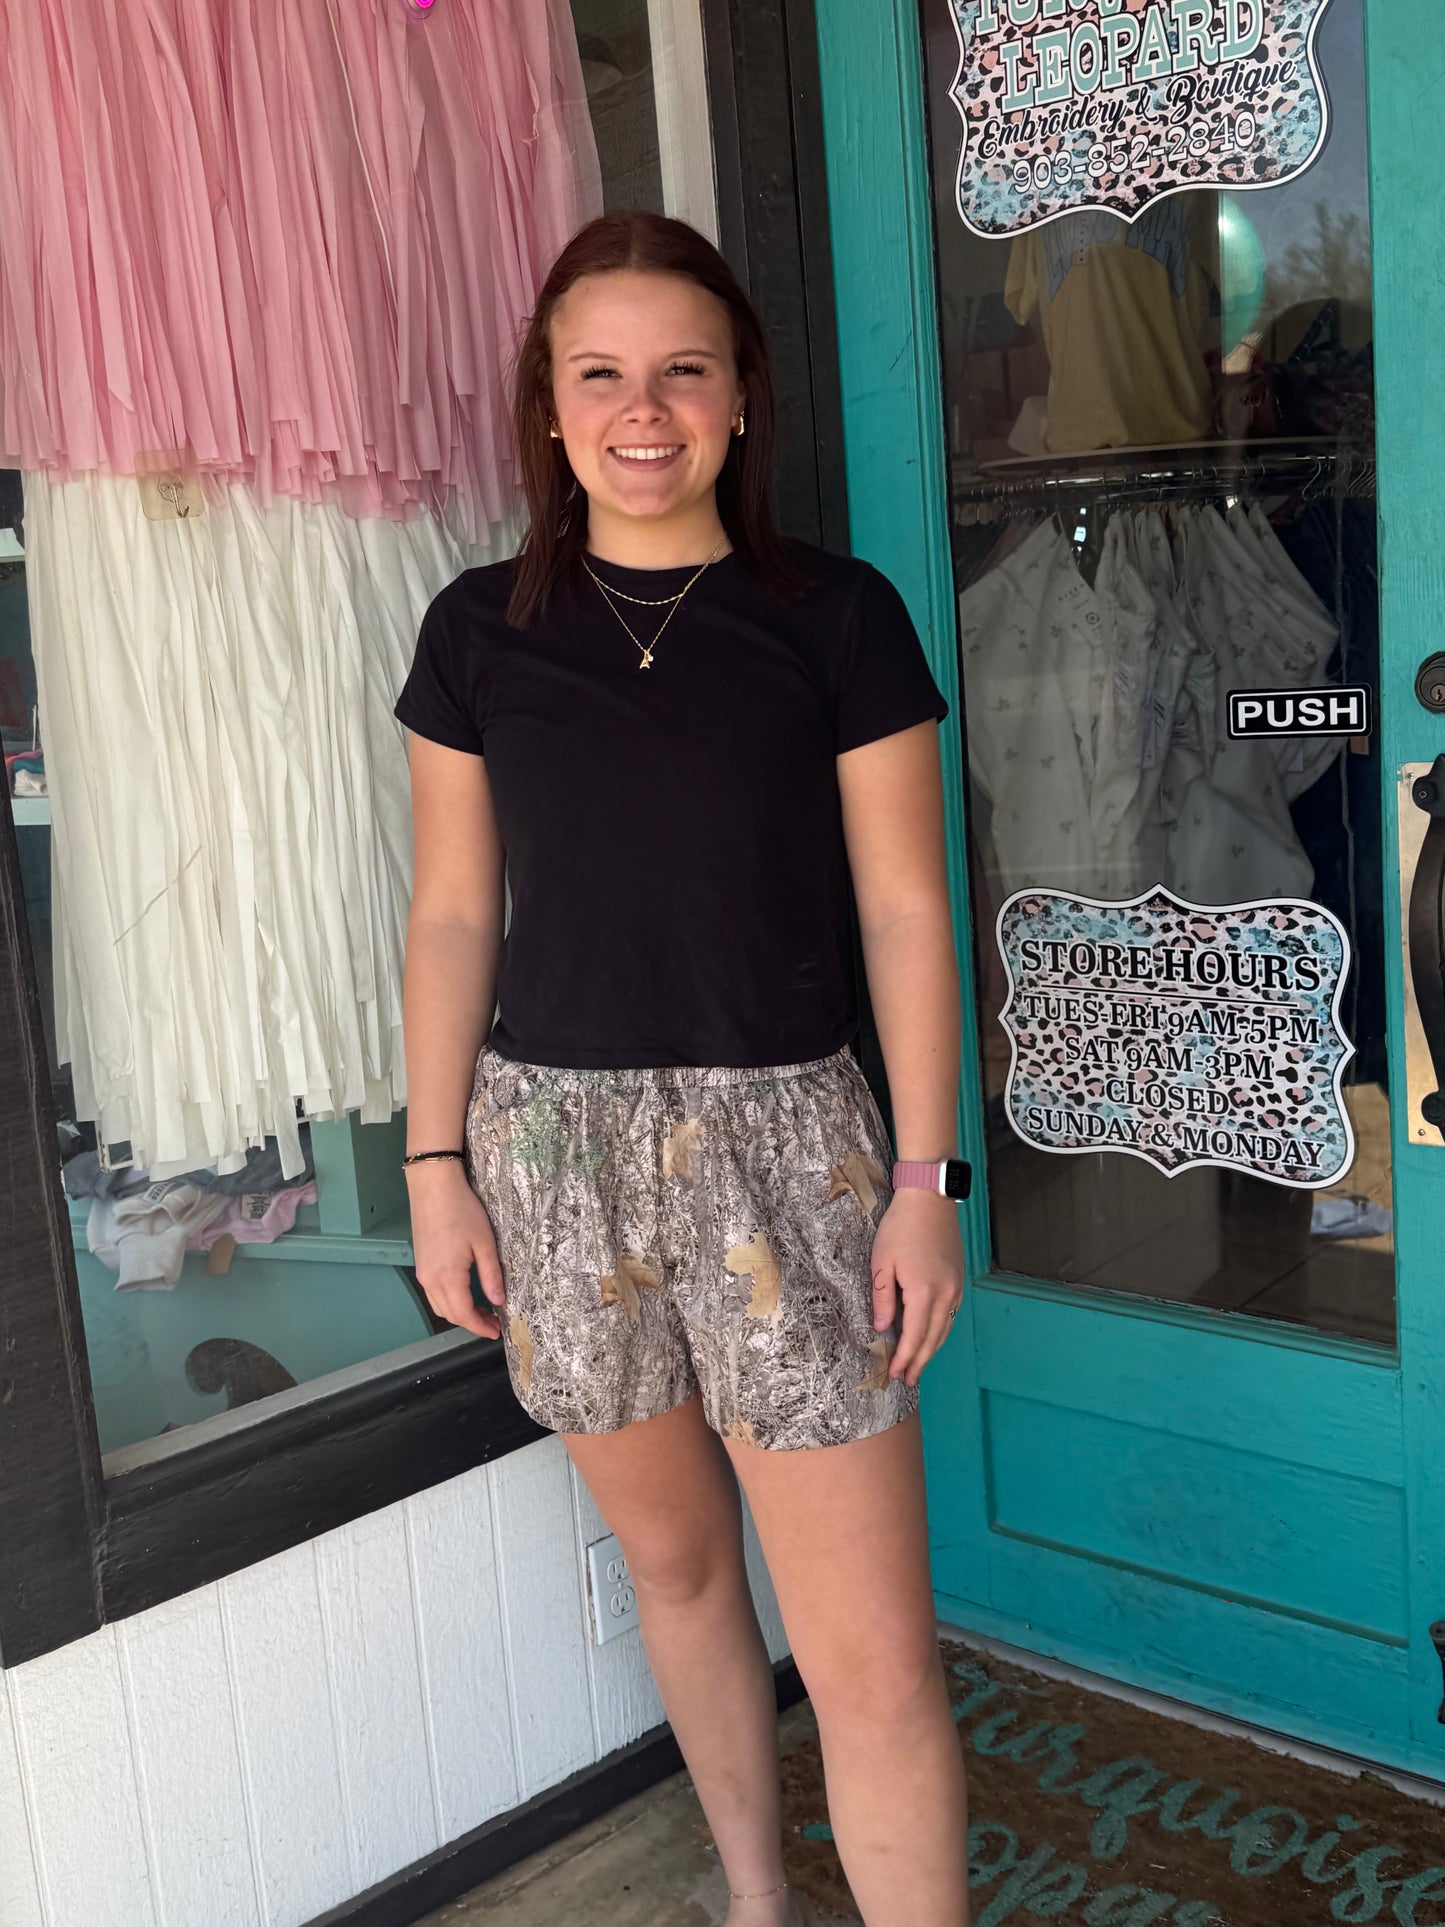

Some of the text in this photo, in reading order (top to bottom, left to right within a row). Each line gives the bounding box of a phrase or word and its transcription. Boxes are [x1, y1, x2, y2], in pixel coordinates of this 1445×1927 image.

[1000, 0, 1265, 113] LEOPARD
[977, 59, 1296, 160] Embroidery & Boutique
[1012, 111, 1257, 194] 903-852-2840
[1237, 696, 1359, 729] PUSH
[1020, 940, 1321, 991] STORE HOURS
[1023, 995, 1320, 1044] TUES-FRI 9AM-5PM
[1065, 1037, 1273, 1081] SAT 9AM-3PM
[1105, 1079, 1230, 1115] CLOSED
[1028, 1107, 1326, 1168] SUNDAY & MONDAY
